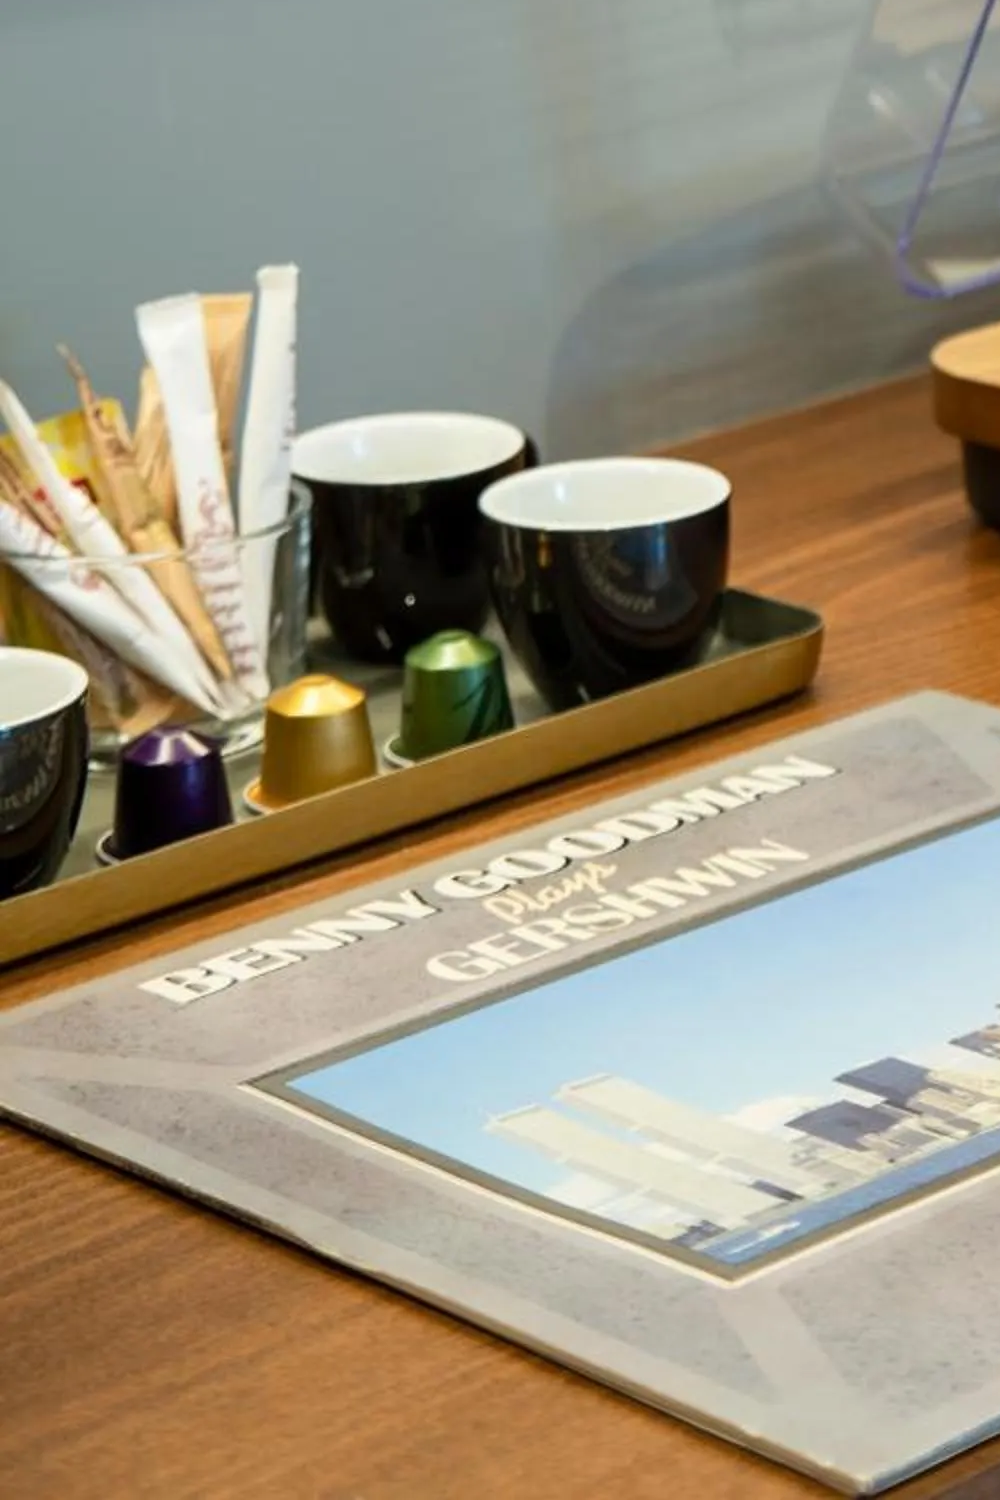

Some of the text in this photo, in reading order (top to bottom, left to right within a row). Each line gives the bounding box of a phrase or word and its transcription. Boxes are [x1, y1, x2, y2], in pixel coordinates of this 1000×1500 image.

[138, 754, 843, 1006] BENNY GOODMAN
[425, 836, 811, 983] GERSHWIN
